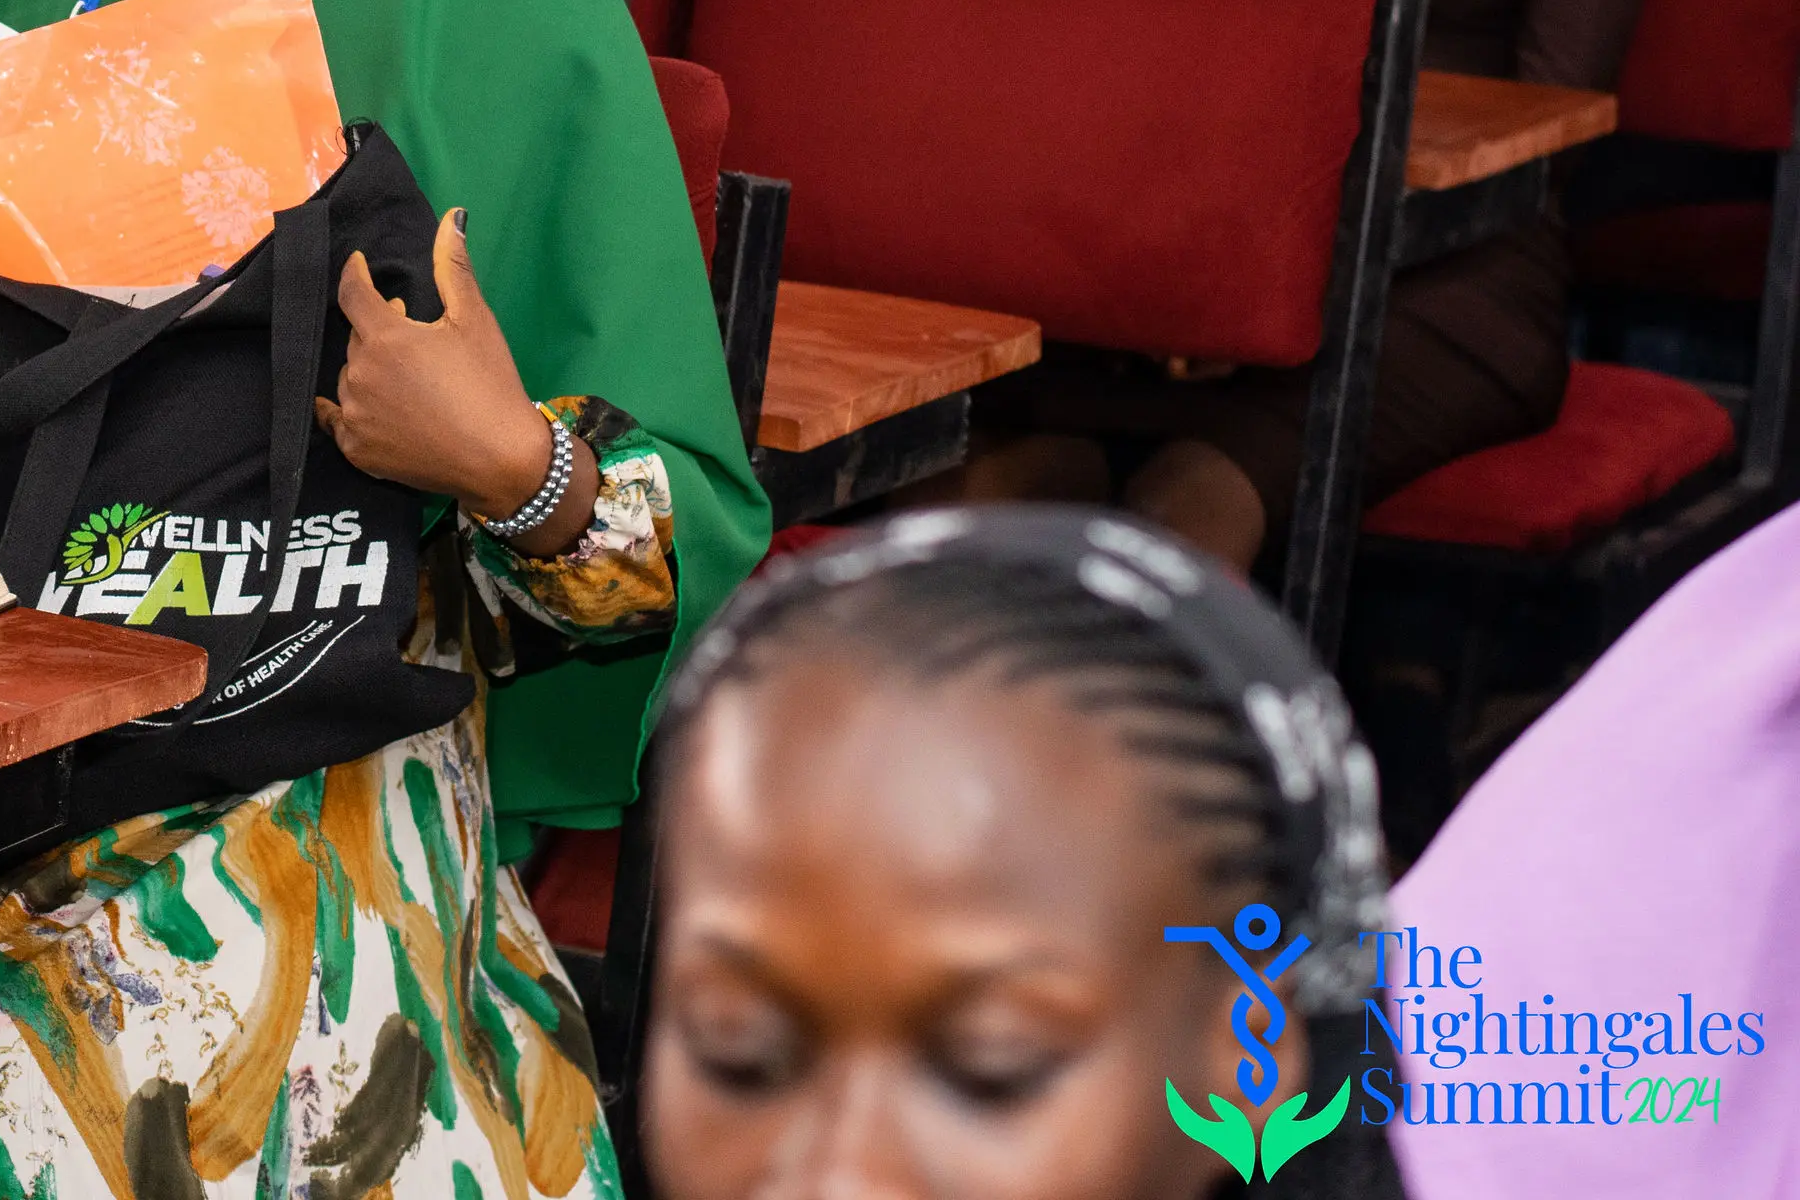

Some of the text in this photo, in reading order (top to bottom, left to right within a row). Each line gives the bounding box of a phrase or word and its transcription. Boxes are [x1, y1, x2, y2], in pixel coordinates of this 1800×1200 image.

[129, 510, 362, 552] WELLNESS
[224, 679, 246, 698] OF
[247, 641, 304, 688] HEALTH
